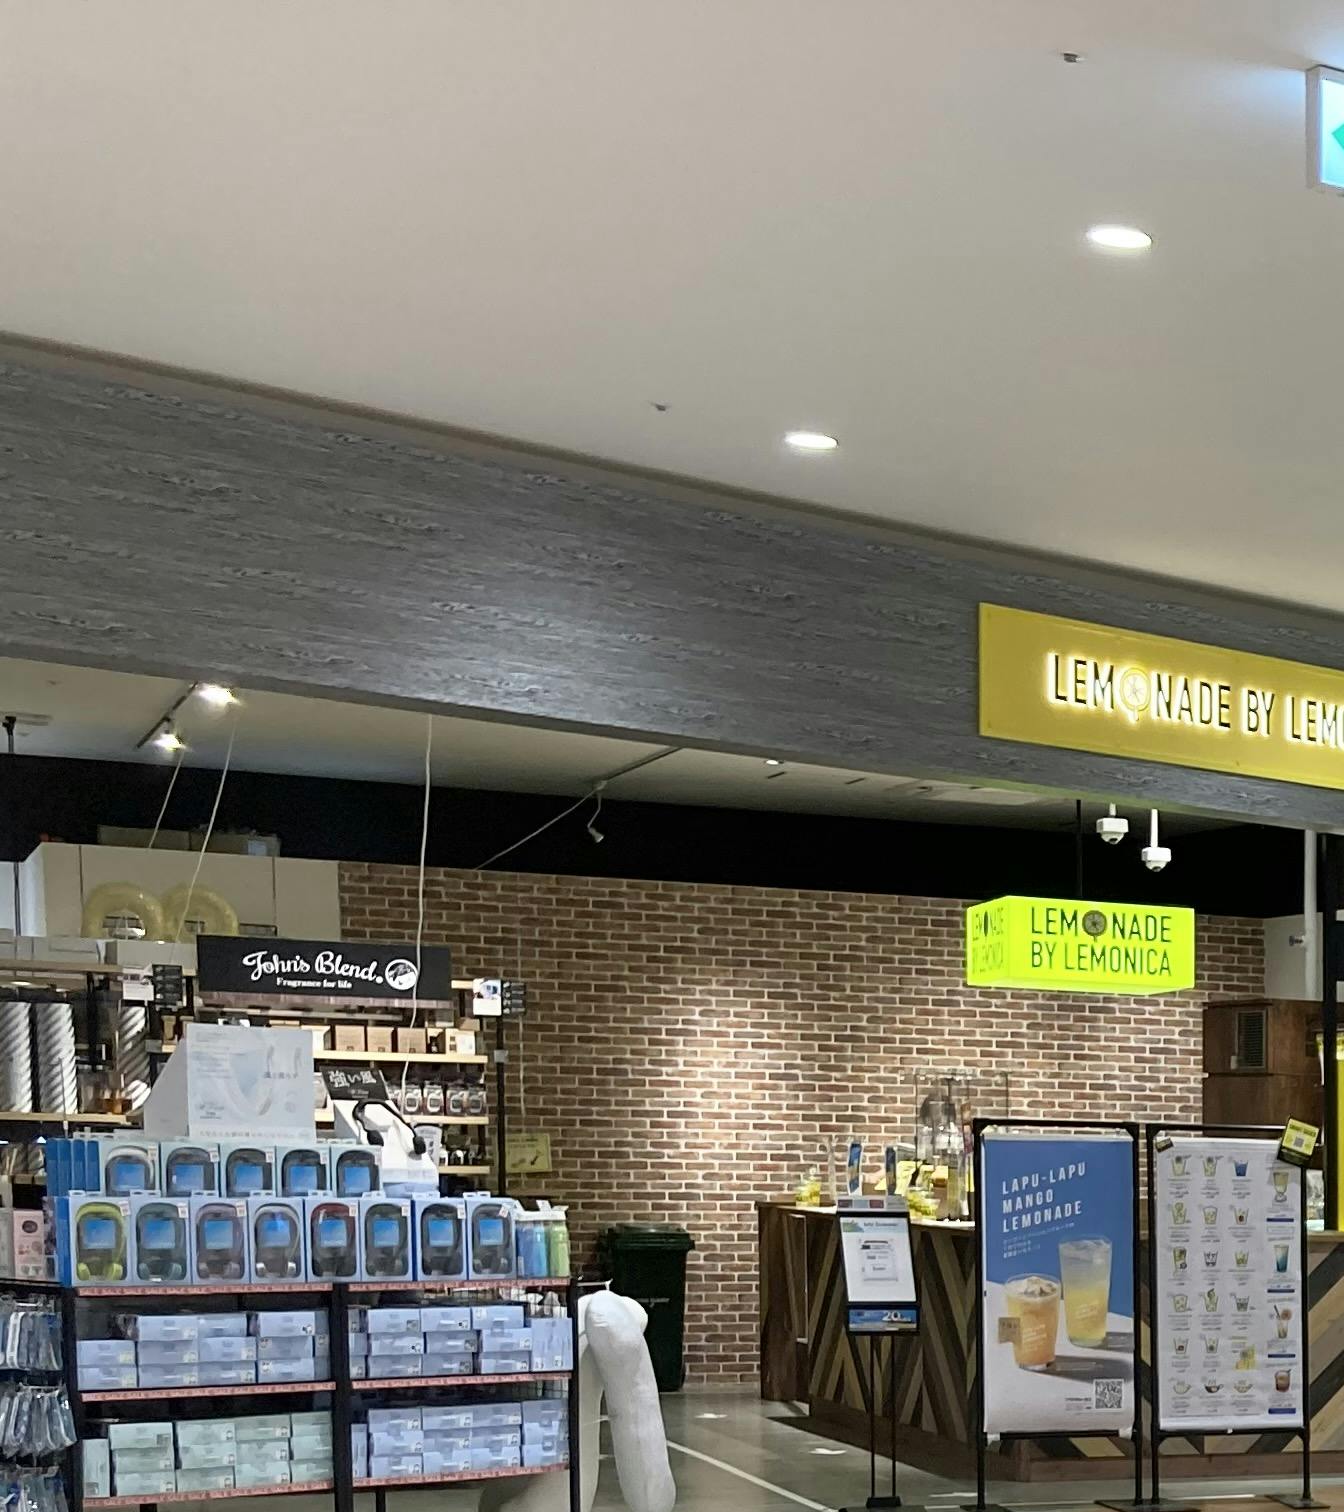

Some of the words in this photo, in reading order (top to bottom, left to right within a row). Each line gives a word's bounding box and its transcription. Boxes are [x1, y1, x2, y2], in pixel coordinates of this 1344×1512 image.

[1049, 653, 1231, 728] LEMONADE
[1244, 688, 1275, 735] BY
[1031, 906, 1172, 943] LEMONADE
[242, 950, 311, 981] John's
[1031, 941, 1057, 968] BY
[1064, 942, 1172, 977] LEMONICA
[276, 977, 321, 988] Fragrance
[322, 978, 336, 988] for
[337, 979, 352, 988] life
[328, 1069, 377, 1088] 強い風
[1002, 1161, 1086, 1195] LAPU-LAPU
[1002, 1188, 1054, 1214] MANGO
[1002, 1200, 1083, 1233] LEMONADE
[881, 1310, 901, 1322] 20
